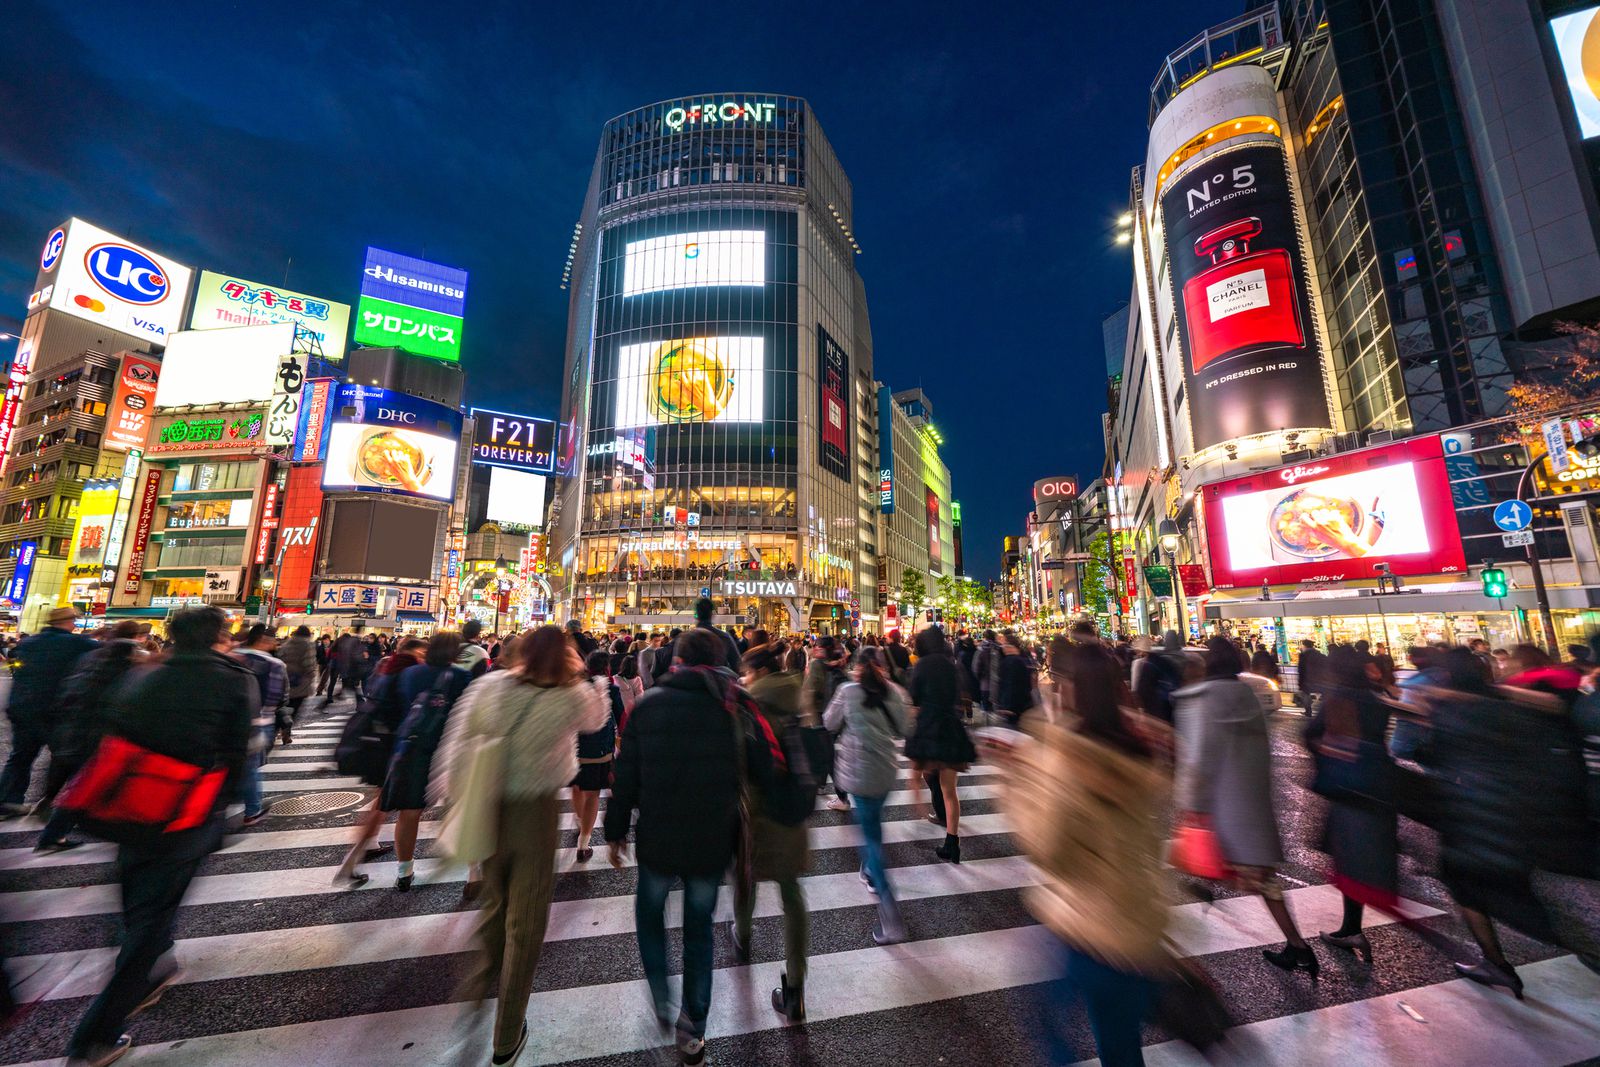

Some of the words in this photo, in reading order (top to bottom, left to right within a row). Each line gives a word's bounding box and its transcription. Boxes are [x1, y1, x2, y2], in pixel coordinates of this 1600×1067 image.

[1189, 199, 1221, 218] LIMITED
[1222, 187, 1257, 202] EDITION
[96, 250, 165, 296] UC
[364, 265, 464, 299] Hisamitsu
[1212, 283, 1263, 303] CHANEL
[1228, 294, 1247, 303] PARIS
[1224, 302, 1254, 314] PARFUM
[133, 316, 165, 336] VISA
[363, 310, 455, 344] サロンパス
[1220, 367, 1263, 384] DRESSED
[1266, 364, 1276, 372] IN
[1278, 361, 1297, 370] RED
[270, 357, 304, 442] もんじゃ
[378, 408, 417, 424] DHC
[491, 417, 535, 447] F21
[473, 443, 533, 464] FOREVER
[536, 452, 549, 466] 21
[1281, 466, 1329, 483] Glico
[1558, 467, 1600, 482] COF
[881, 469, 891, 505] SEIBU
[170, 517, 226, 528] Euphoria
[621, 540, 689, 553] STARBUCKS
[696, 540, 742, 550] COFFEE
[724, 581, 797, 596] TSUTAYA
